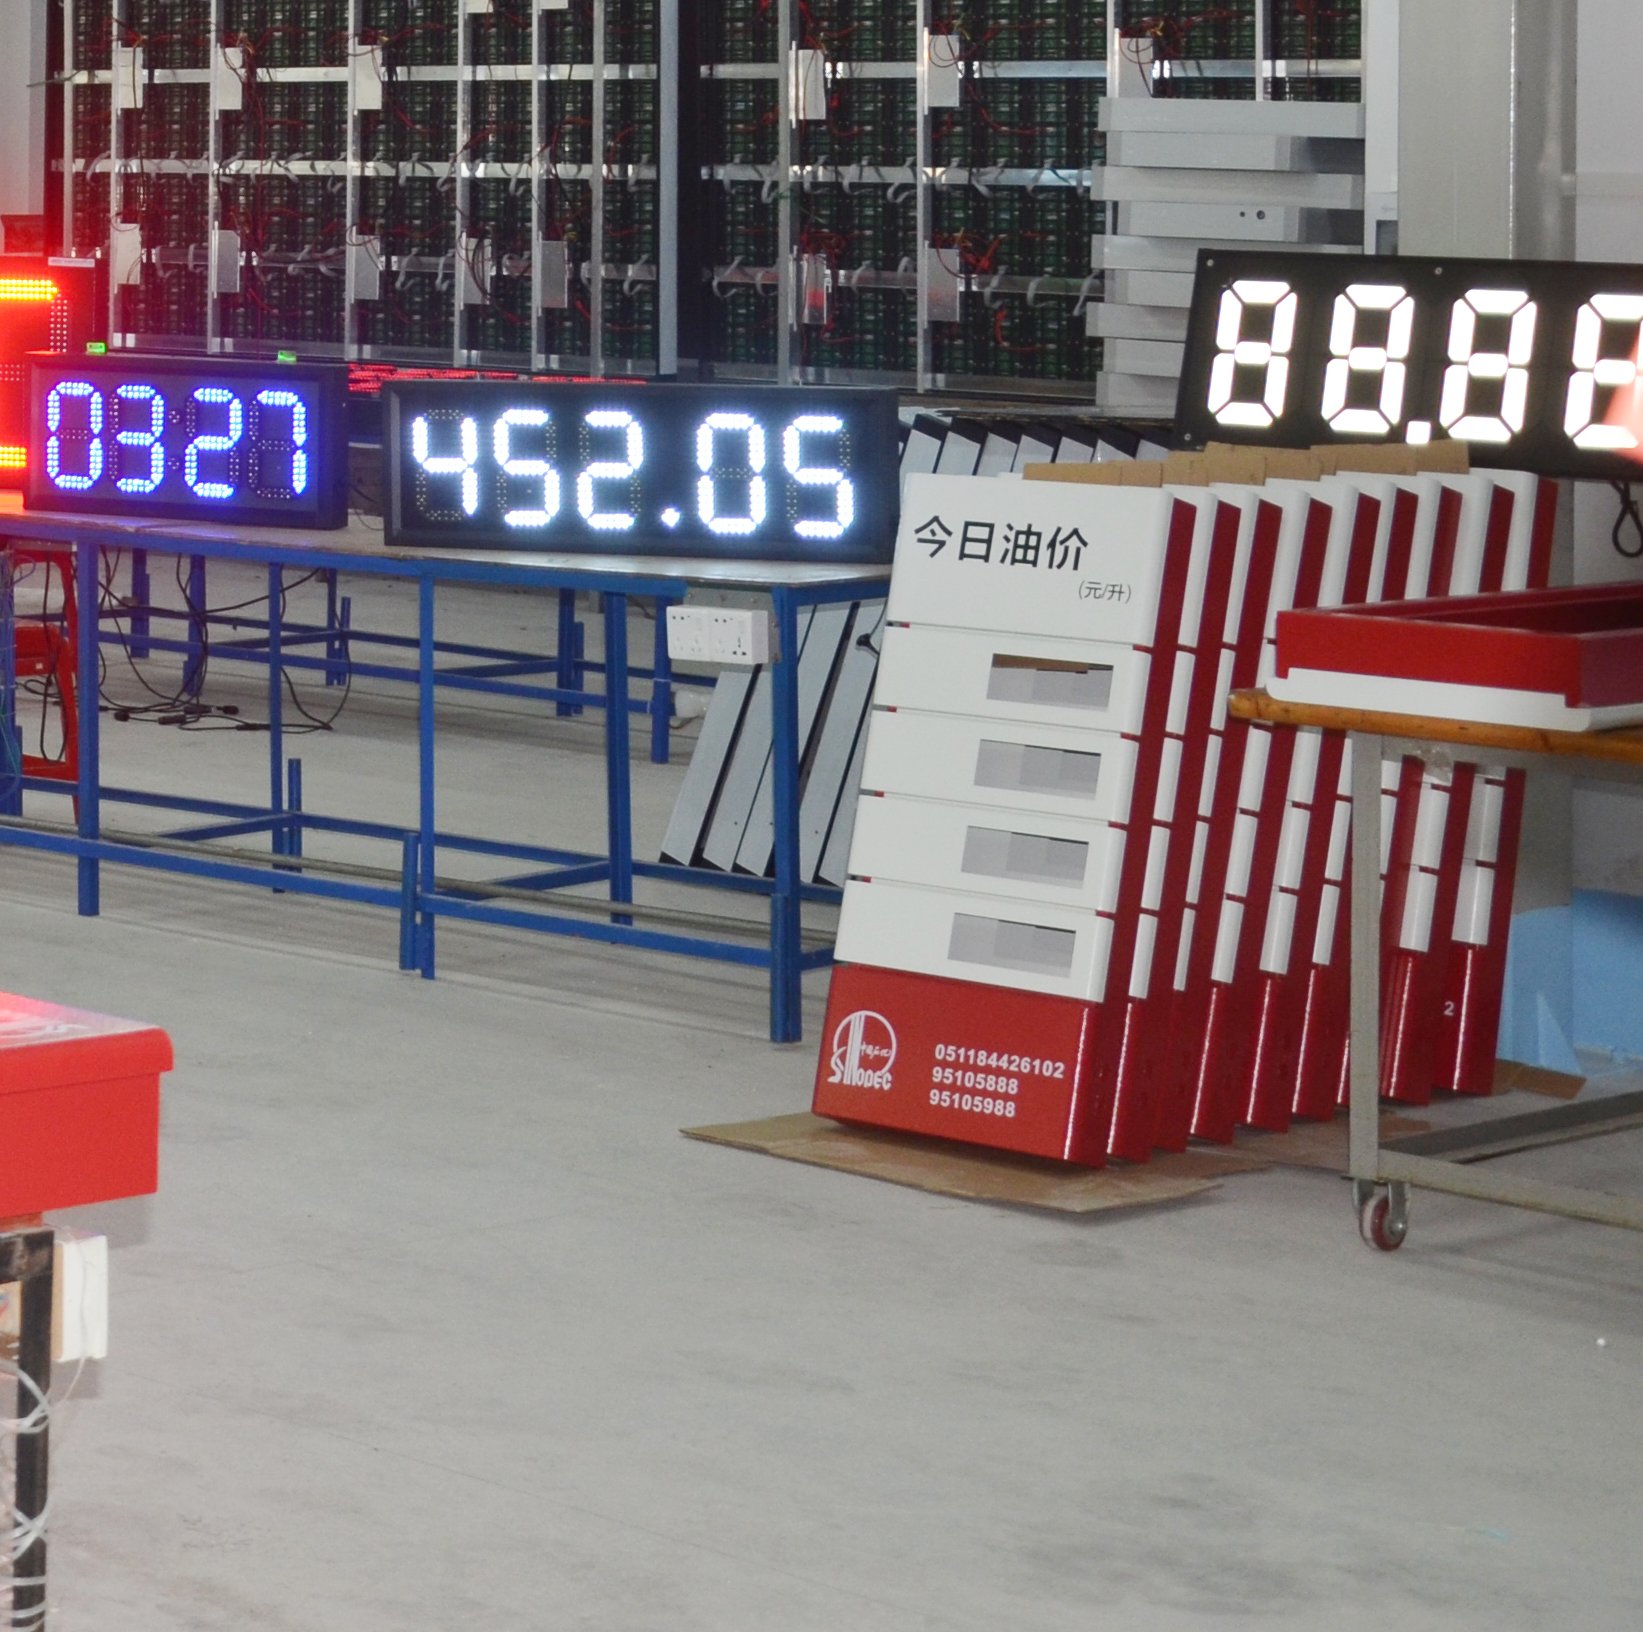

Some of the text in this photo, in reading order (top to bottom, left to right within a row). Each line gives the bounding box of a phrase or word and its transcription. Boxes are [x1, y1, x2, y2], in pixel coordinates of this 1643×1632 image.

[46, 381, 307, 499] 0327
[411, 408, 855, 539] 452.05
[914, 515, 1088, 571] 今日油价
[1078, 580, 1131, 603] (元/升)
[934, 1043, 1065, 1079] 051184426102
[932, 1067, 1018, 1095] 95105888
[929, 1089, 1016, 1118] 95105988
